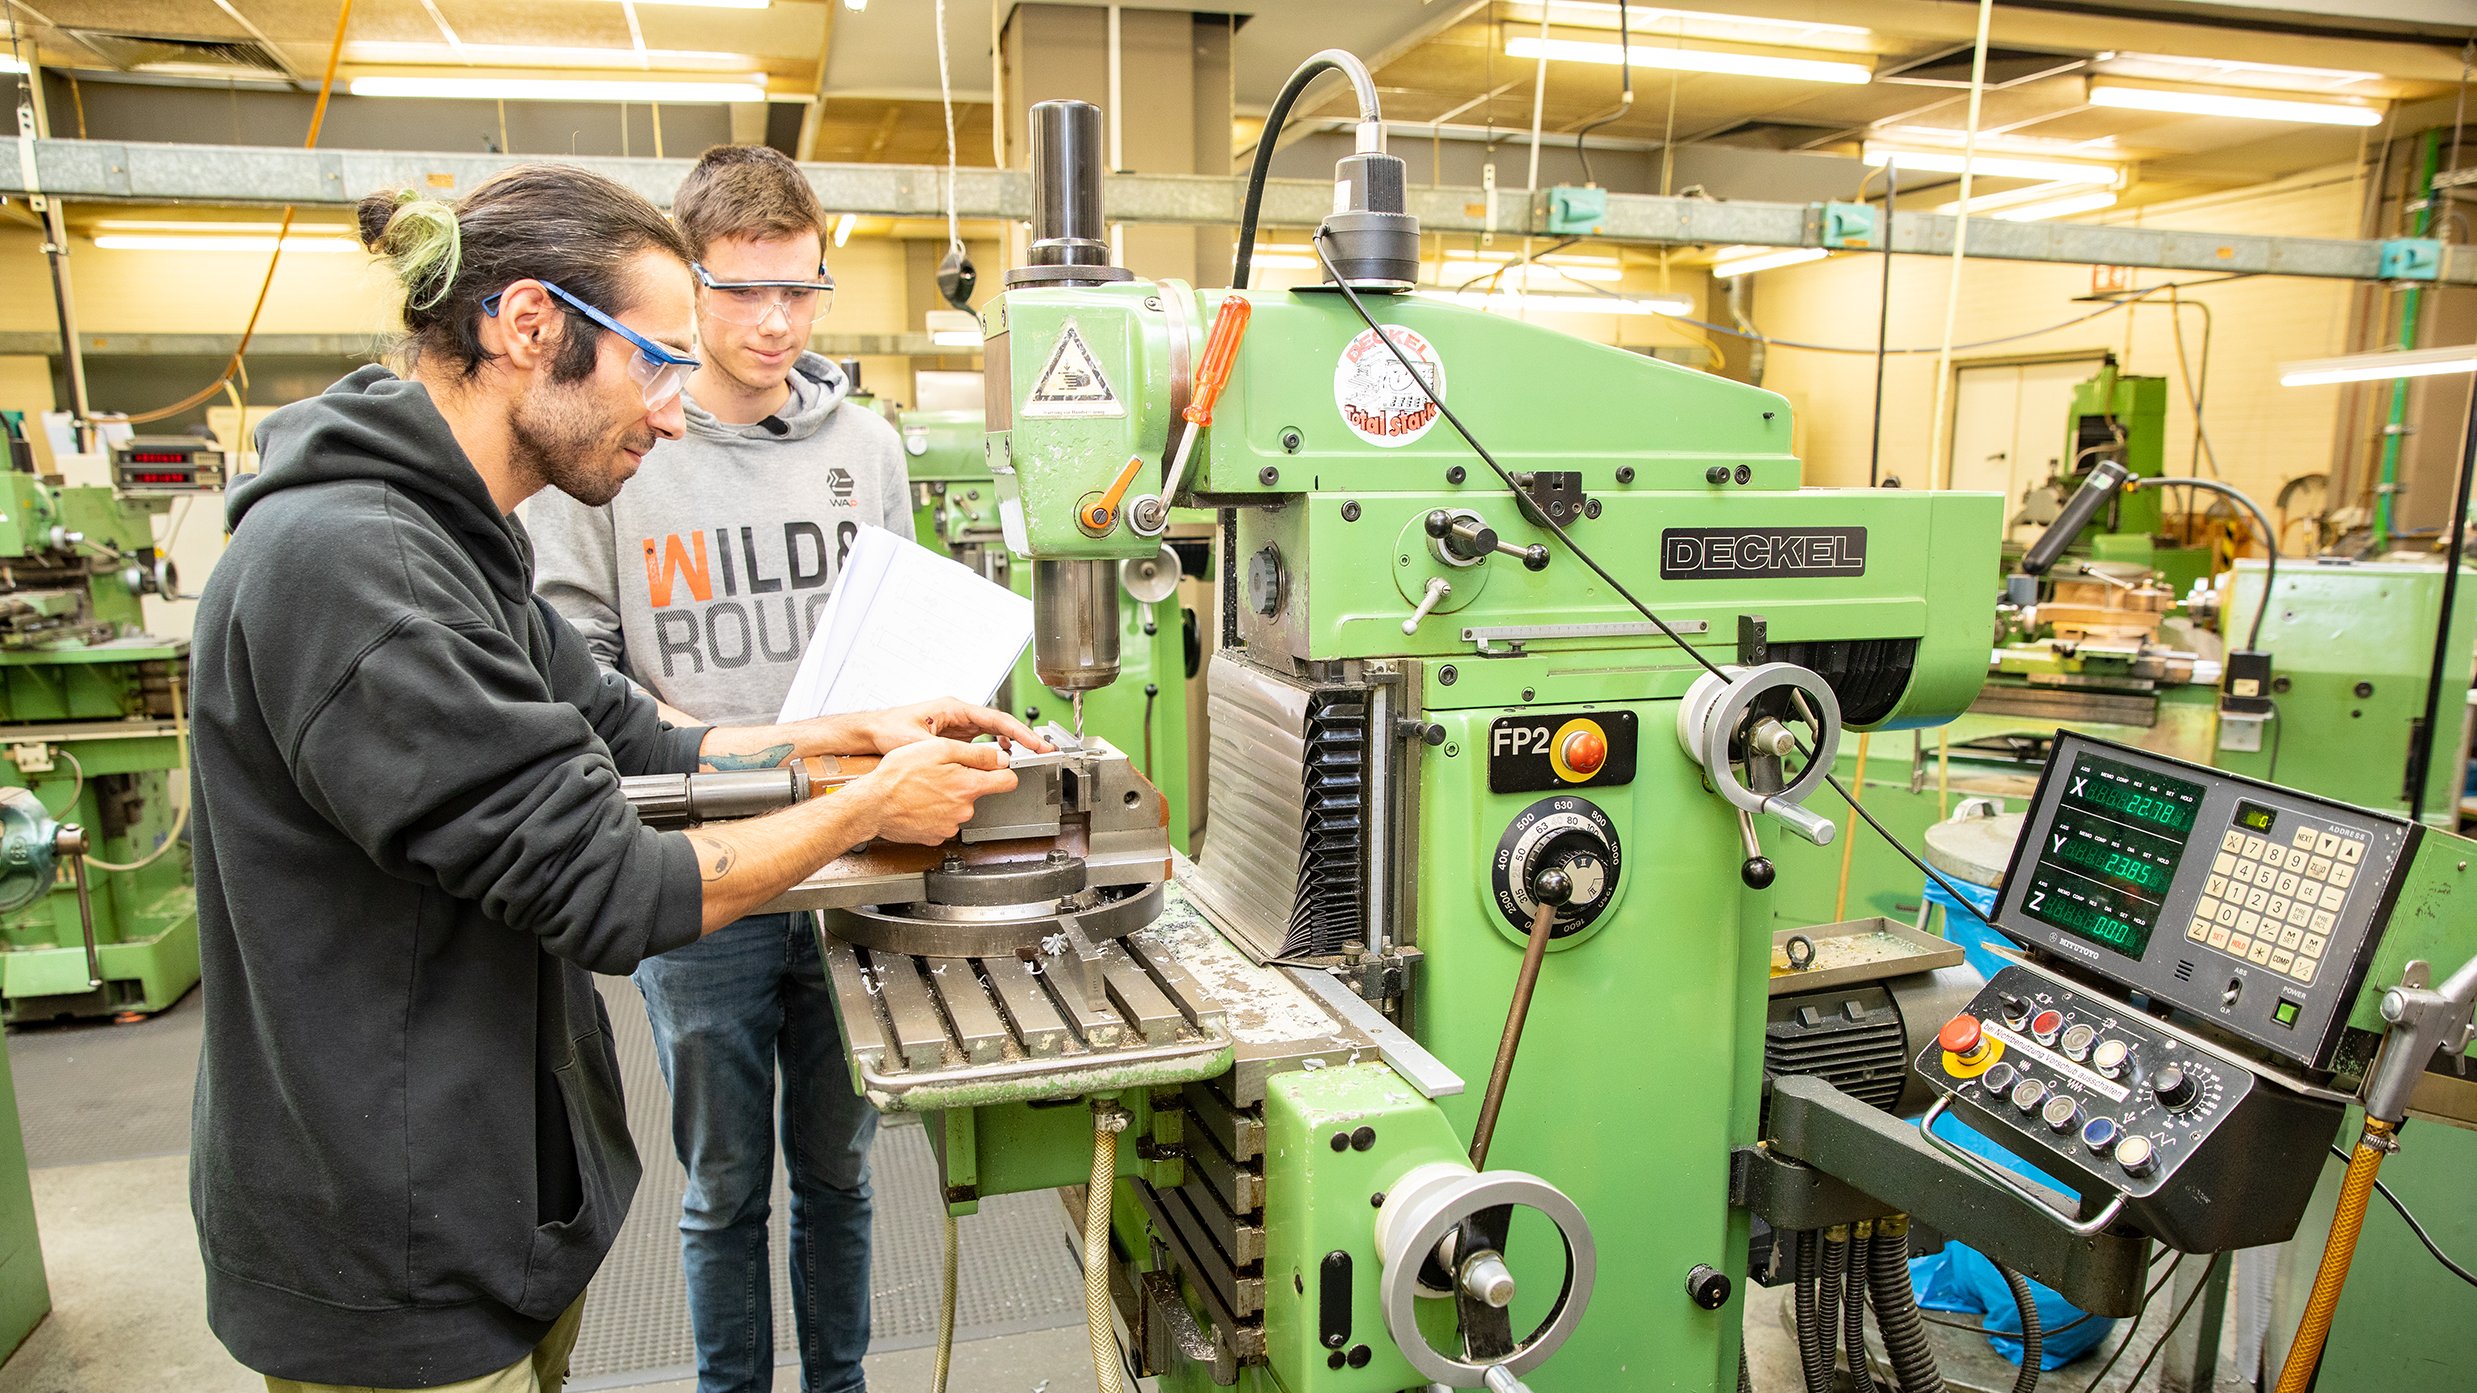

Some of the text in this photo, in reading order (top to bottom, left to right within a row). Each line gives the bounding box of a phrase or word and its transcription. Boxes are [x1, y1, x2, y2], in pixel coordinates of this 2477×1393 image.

[1345, 329, 1428, 364] DECKEL
[1344, 402, 1437, 437] Total stark
[1666, 534, 1863, 571] DECKEL
[1493, 726, 1550, 757] FP2
[2069, 776, 2088, 797] X
[2100, 771, 2114, 780] MEMO
[2116, 776, 2129, 784] COMP
[2133, 780, 2143, 788] RES
[2180, 794, 2193, 803] HOLD
[1554, 800, 1573, 810] 630
[1516, 812, 1535, 831] 500
[1566, 815, 1579, 826] 80
[1591, 810, 1607, 827] 800
[1535, 822, 1549, 834] 63
[2328, 825, 2366, 840] ADDRESS
[2053, 833, 2067, 854] Y
[2227, 835, 2239, 848] X
[2296, 833, 2313, 843] NEXT
[1610, 841, 1620, 866] 1000
[2079, 830, 2092, 839] MEMO
[2094, 835, 2107, 844] COMP
[2142, 851, 2152, 859] SET
[2157, 856, 2170, 865] HOLD
[2249, 842, 2258, 853] 7
[1497, 849, 1510, 871] 400
[1515, 848, 1527, 862] 50
[2269, 849, 2279, 860] 8
[2291, 855, 2301, 867] 9
[2240, 865, 2248, 876] 4
[2260, 871, 2270, 883] 5
[2212, 880, 2221, 892] Y
[2281, 878, 2291, 890] 6
[2233, 887, 2239, 898] 1
[2304, 887, 2314, 896] CE
[1499, 890, 1517, 915] 2500
[2028, 890, 2046, 912] Z
[2251, 893, 2261, 906] 2
[2057, 887, 2071, 896] MEMO
[2072, 892, 2085, 902] COMP
[2088, 899, 2098, 907] RES
[2104, 905, 2112, 913] DIA
[2119, 911, 2129, 919] SET
[2133, 917, 2146, 926] HOLD
[2272, 901, 2283, 913] 3
[1563, 917, 1586, 933] 1600
[2193, 923, 2204, 936] Z
[2212, 932, 2223, 942] SET
[2059, 937, 2100, 960] MITUTOYO
[2231, 939, 2246, 950] HOLD
[2272, 954, 2290, 966] COMP
[2233, 967, 2248, 977] ABS
[2282, 985, 2307, 1000] POWER
[1983, 1023, 2122, 1097] bei Nichtbenutzung Vorschub ausschalten
